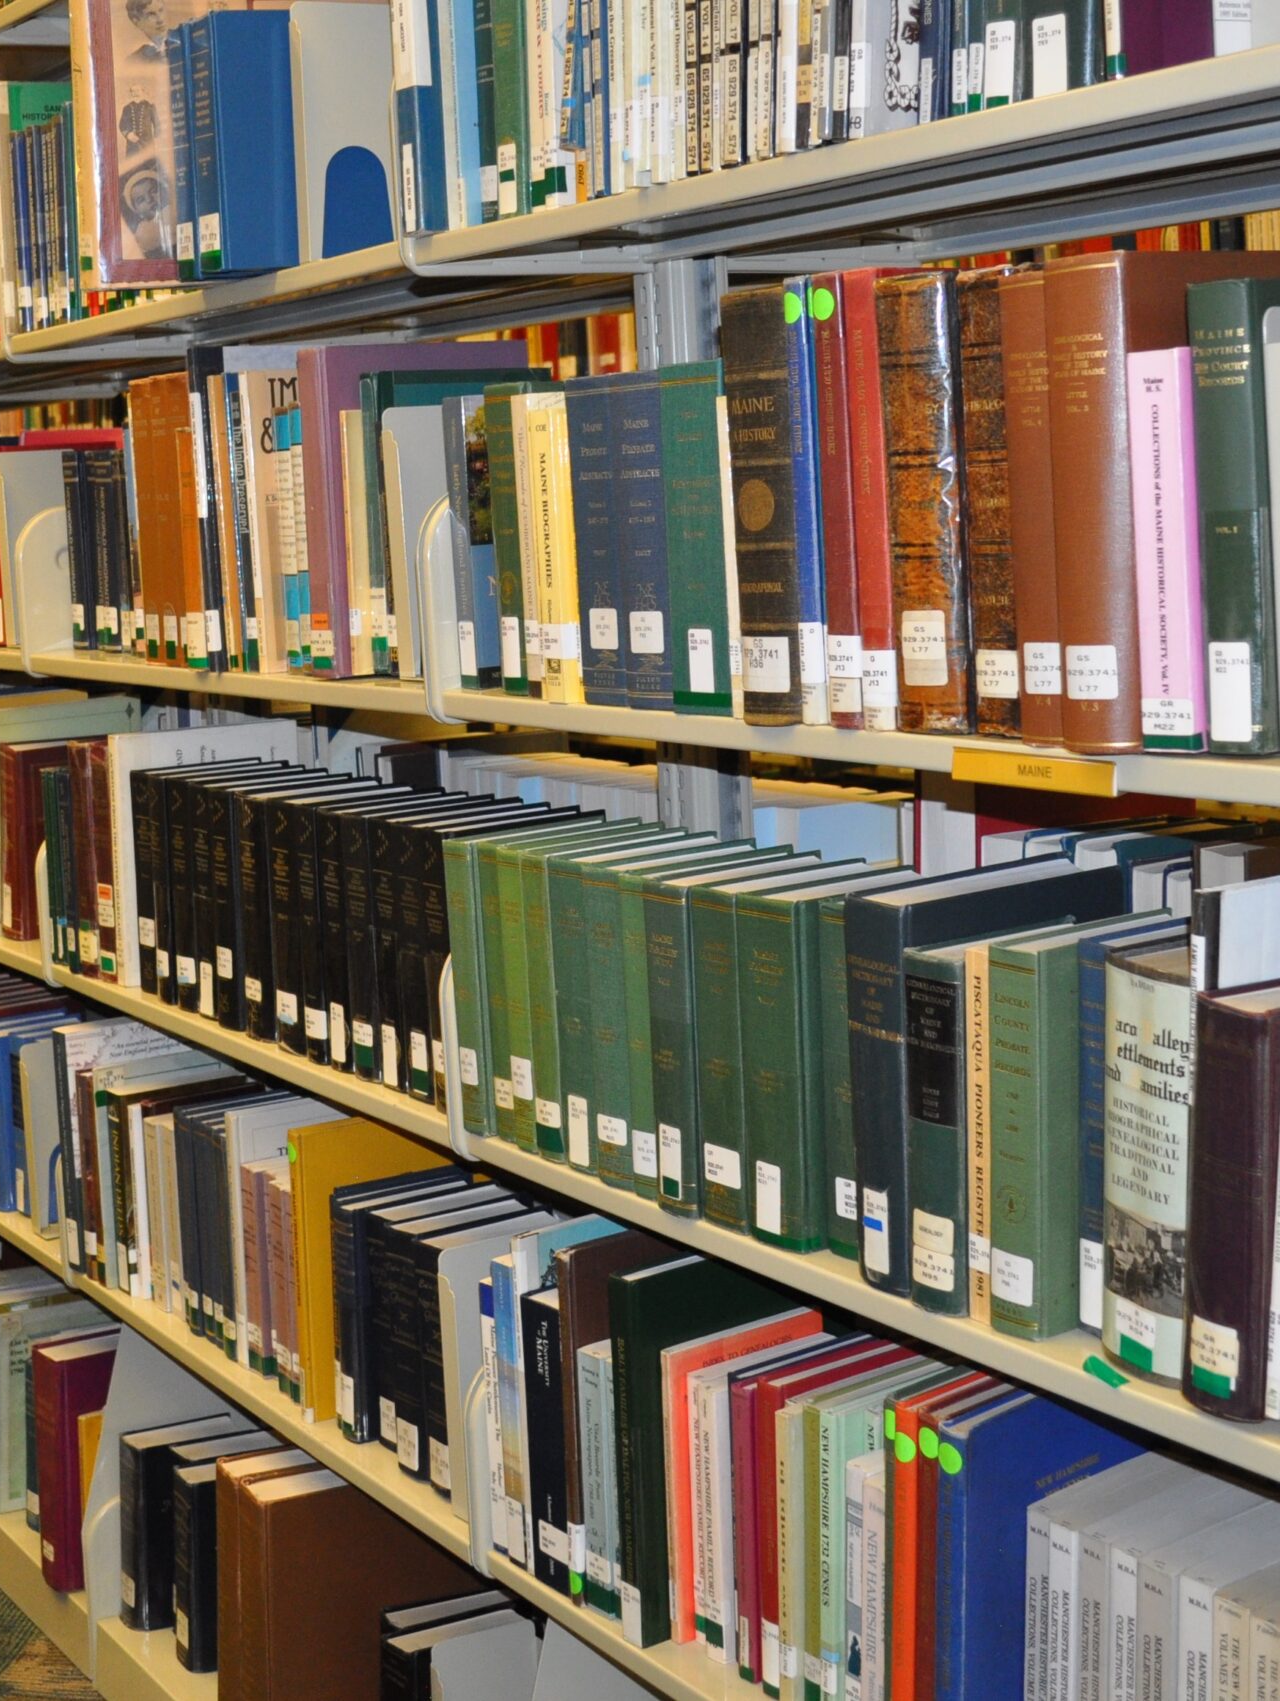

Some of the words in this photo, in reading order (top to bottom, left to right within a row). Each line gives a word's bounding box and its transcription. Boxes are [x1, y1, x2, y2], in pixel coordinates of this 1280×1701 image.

[687, 13, 695, 40] VOL.
[702, 5, 710, 31] VOL.
[702, 35, 710, 48] 14
[730, 28, 738, 40] 17
[687, 44, 695, 56] 12
[687, 72, 695, 86] GS
[702, 68, 710, 82] GS
[728, 59, 736, 73] GS
[1195, 327, 1246, 340] MAINE
[1143, 377, 1164, 385] Maine
[732, 396, 776, 415] MAINE
[739, 426, 778, 442] HISTORY
[1151, 404, 1161, 480] COLLECTIONS
[539, 452, 549, 497] MAINE
[1154, 508, 1164, 544] MAINE
[542, 500, 553, 589] BIOGRAPHIES
[1155, 546, 1166, 612] HISTORICAL
[913, 625, 926, 633] GS
[984, 659, 996, 667] GS
[1032, 652, 1045, 660] GS
[983, 680, 1000, 688] L77
[1067, 669, 1119, 677] 929.3741
[1160, 700, 1174, 708] GR
[1153, 723, 1176, 731] M22
[1017, 764, 1053, 779] MAINE
[971, 975, 983, 1073] PISCATAQUA
[1113, 1042, 1185, 1078] ettlements
[974, 1083, 984, 1158] PIONEERS
[1112, 1097, 1170, 1128] HISTORICAL
[1109, 1141, 1175, 1176] TRADITIONAL
[1111, 1173, 1170, 1206] LEGENDARY
[1131, 1167, 1149, 1182] AND
[975, 1166, 984, 1237] REGISTER
[914, 1257, 954, 1276] 929.3741
[976, 1271, 984, 1298] 1981
[536, 1336, 544, 1375] MAINE
[542, 1339, 550, 1387] UNIVERSITY
[728, 1352, 738, 1361] TO
[702, 1429, 711, 1455] NEW
[821, 1426, 830, 1456] NEW
[704, 1456, 712, 1515] HAMPSHIRE
[821, 1458, 830, 1530] HAMPSHIRE
[705, 1518, 713, 1553] FAMILY
[822, 1532, 830, 1557] 1732
[867, 1529, 877, 1567] NEW
[822, 1559, 830, 1607] CENSUS
[867, 1570, 877, 1663] HAMPSHIRE
[1027, 1576, 1038, 1650] COLLECTIONS,
[1038, 1574, 1049, 1645] MANCHESTER
[1049, 1589, 1060, 1664] COLLECTIONS,
[1060, 1589, 1071, 1662] MANCHESTER
[1079, 1597, 1090, 1673] COLLECTIONS,
[1091, 1599, 1102, 1673] MANCHESTER
[1113, 1614, 1124, 1691] COLLECTIONS,
[1125, 1615, 1136, 1690] MANCHESTER
[1218, 1632, 1228, 1685] VOLUMES
[1231, 1637, 1240, 1660] THE
[1026, 1653, 1036, 1696] VOLUME
[1038, 1647, 1048, 1696] HISTORIC
[1231, 1664, 1240, 1689] NEW
[1270, 1659, 1278, 1682] THE
